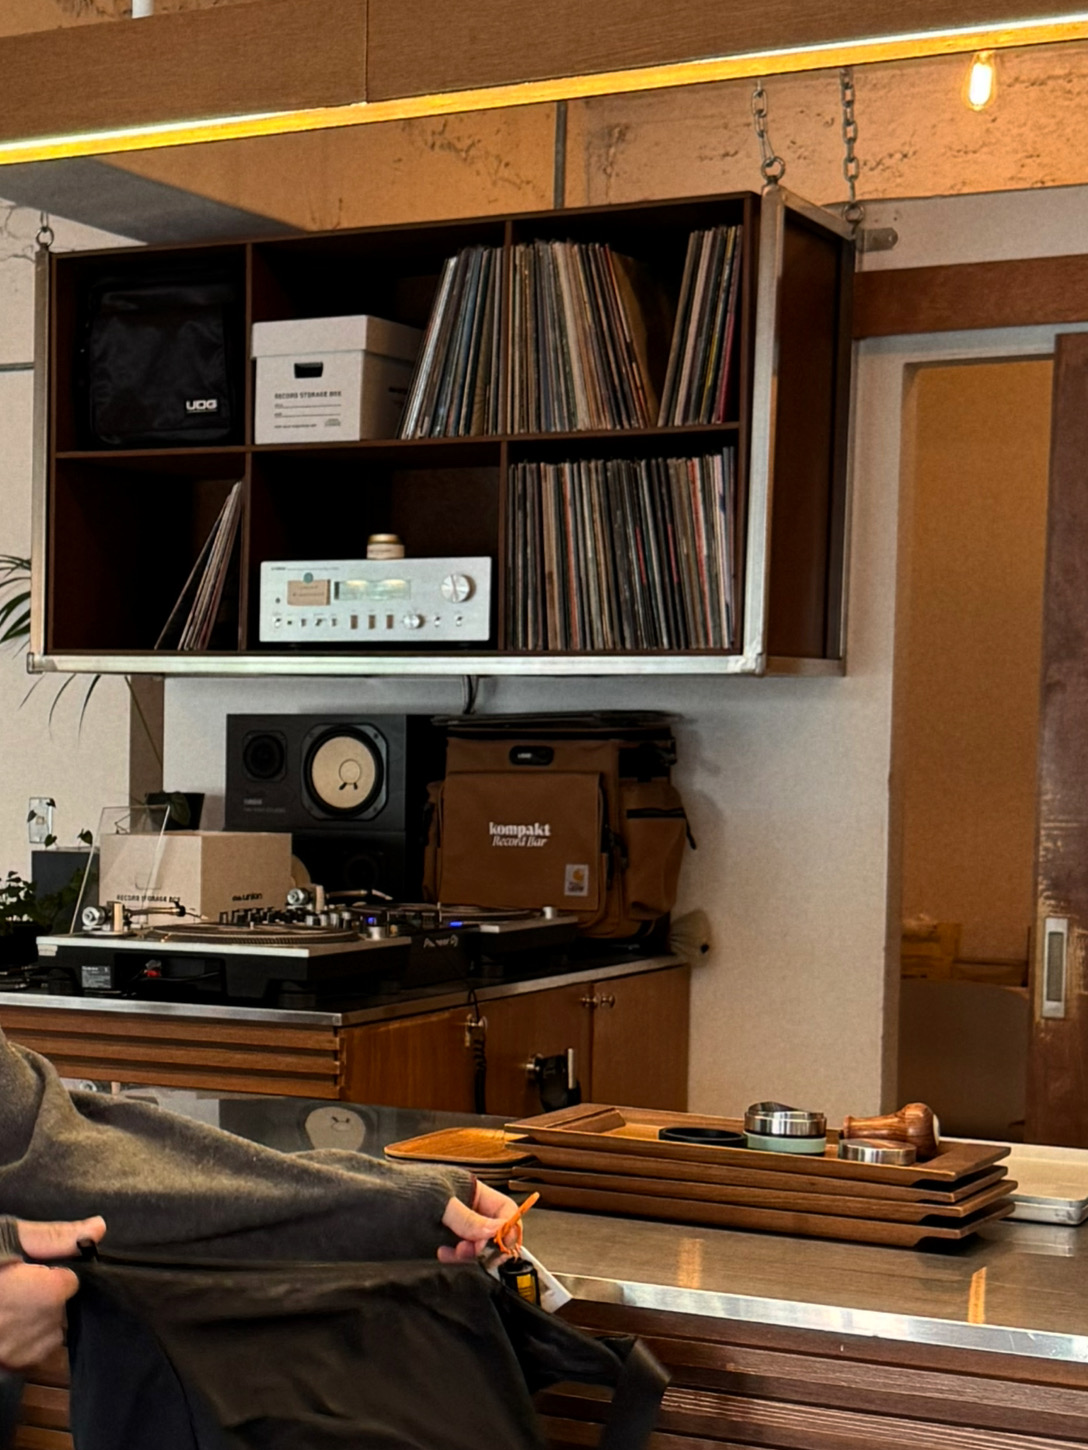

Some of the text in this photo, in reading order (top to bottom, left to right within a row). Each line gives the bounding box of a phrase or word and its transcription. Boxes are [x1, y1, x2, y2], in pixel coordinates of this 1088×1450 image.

[299, 390, 328, 399] STORAGE
[488, 821, 552, 839] kompakt
[492, 835, 549, 847] Record Bar
